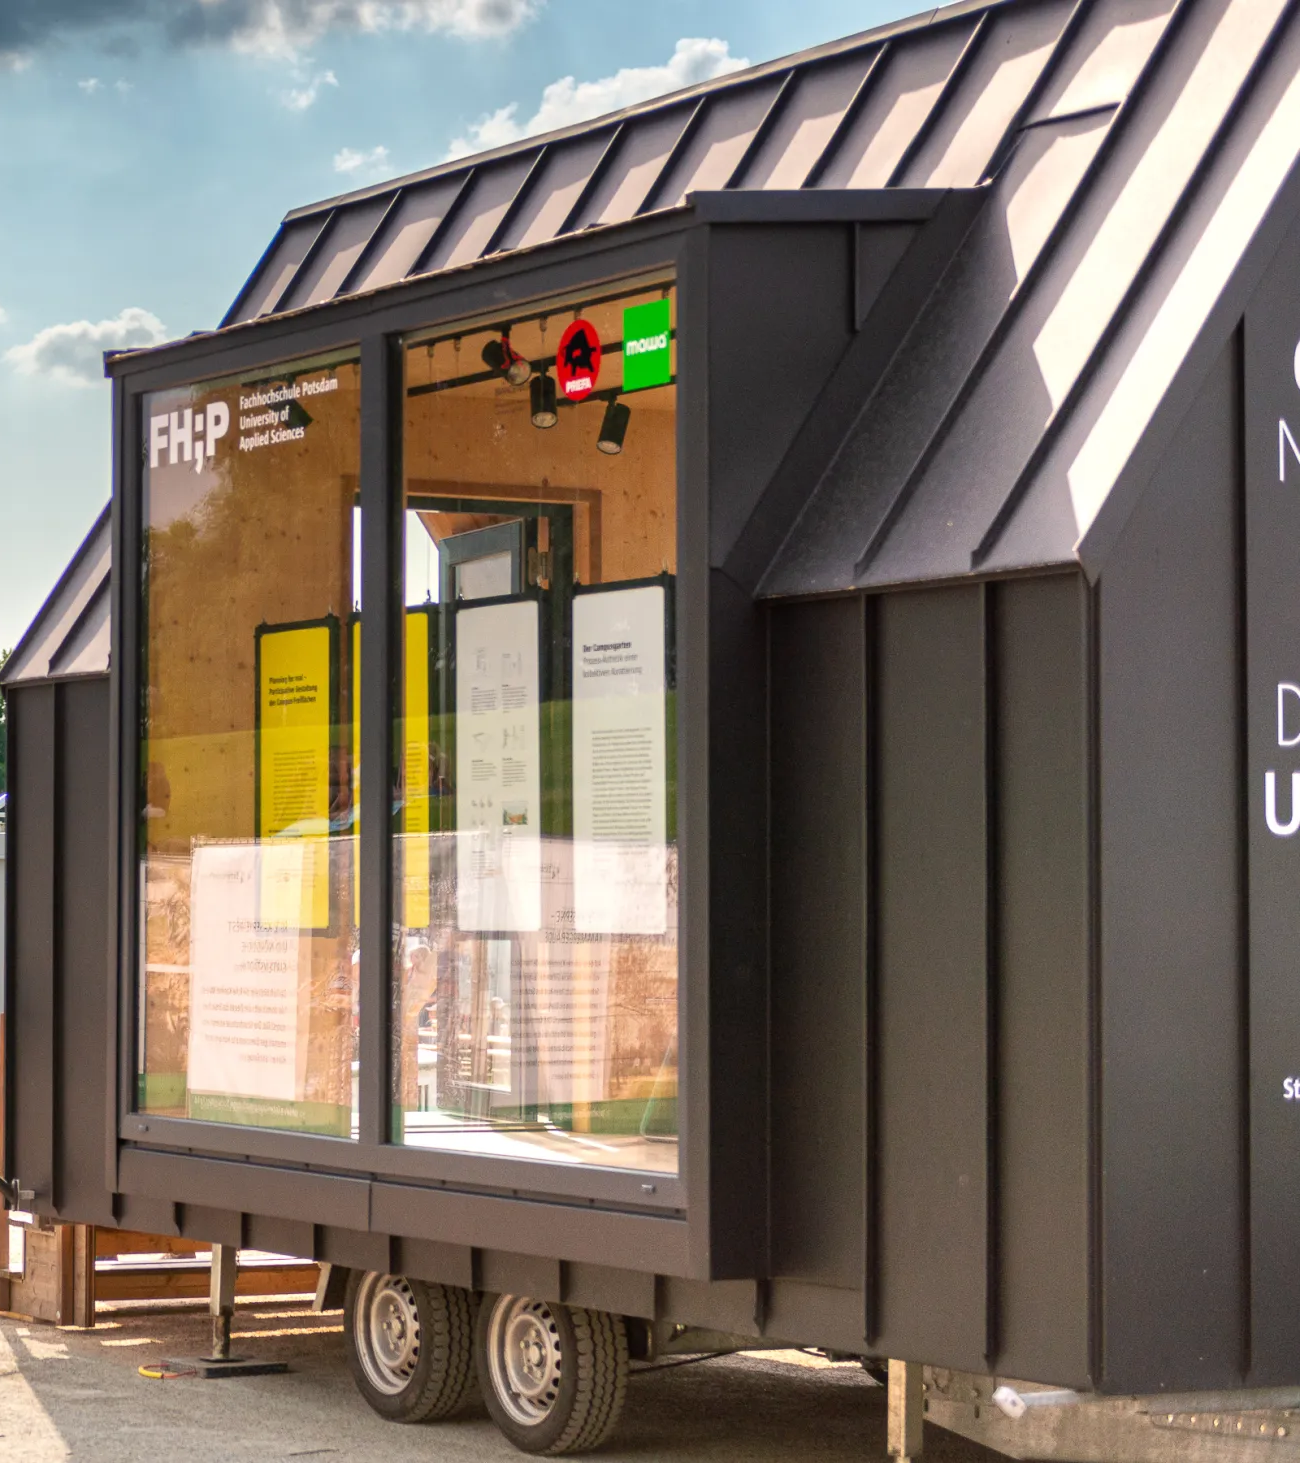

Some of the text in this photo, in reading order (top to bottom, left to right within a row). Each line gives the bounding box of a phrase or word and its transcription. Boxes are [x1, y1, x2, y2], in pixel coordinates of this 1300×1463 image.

[627, 334, 668, 356] mowa
[240, 378, 338, 410] Fachhochschule Potsdam
[240, 405, 290, 430] University of
[239, 427, 305, 452] Applied Sciences
